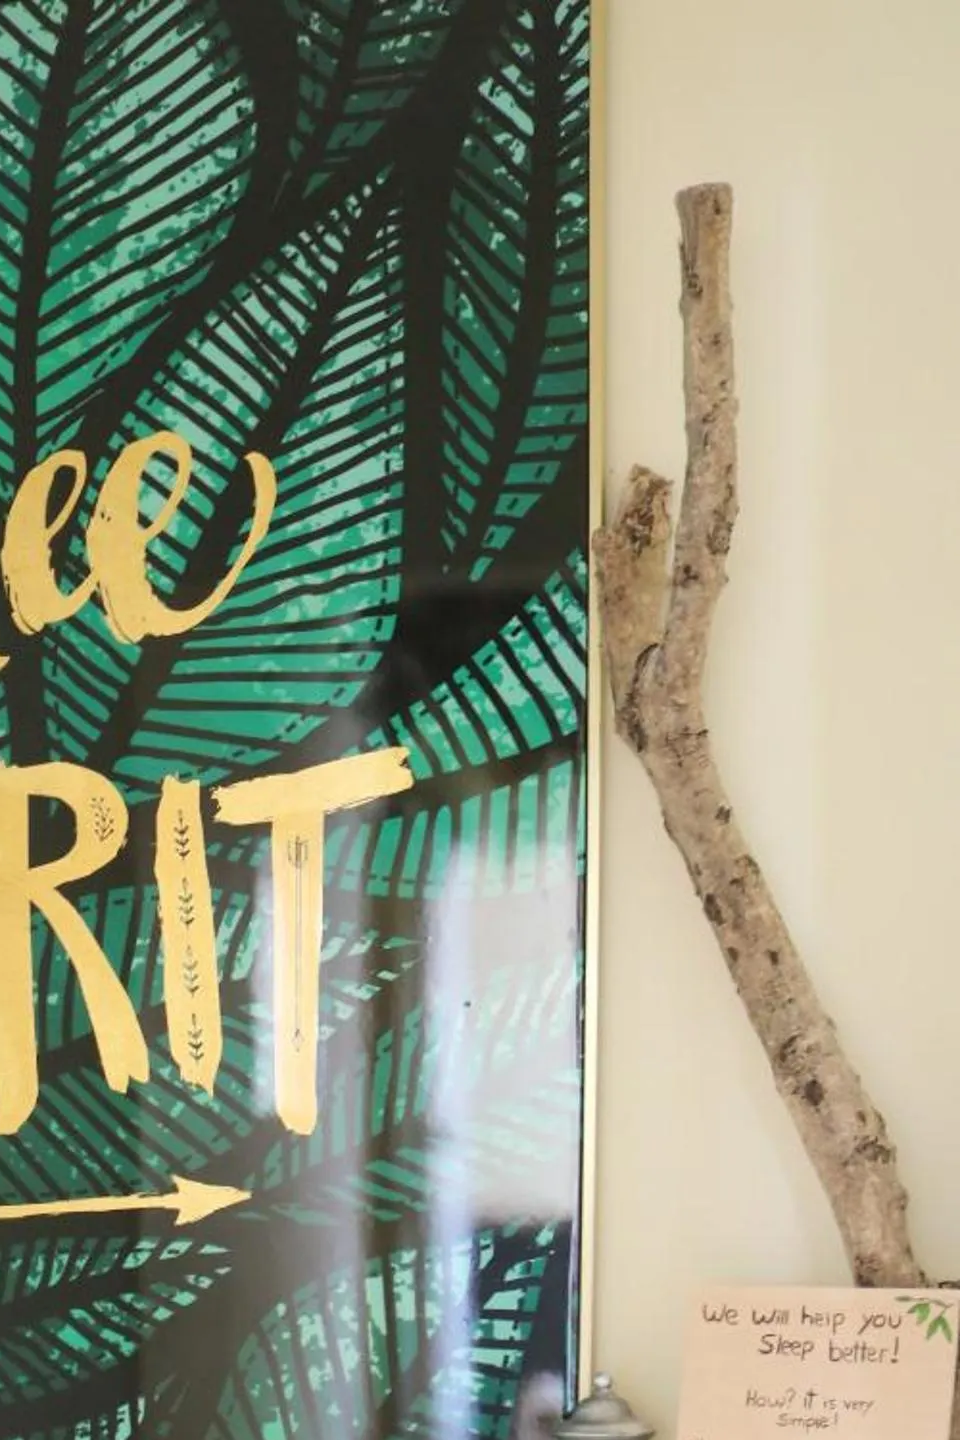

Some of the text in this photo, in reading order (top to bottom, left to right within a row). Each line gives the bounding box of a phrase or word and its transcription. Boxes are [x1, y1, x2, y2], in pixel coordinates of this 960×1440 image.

[702, 1303, 739, 1326] We
[800, 1304, 846, 1334] help
[857, 1312, 903, 1335] you
[828, 1336, 900, 1364] better!
